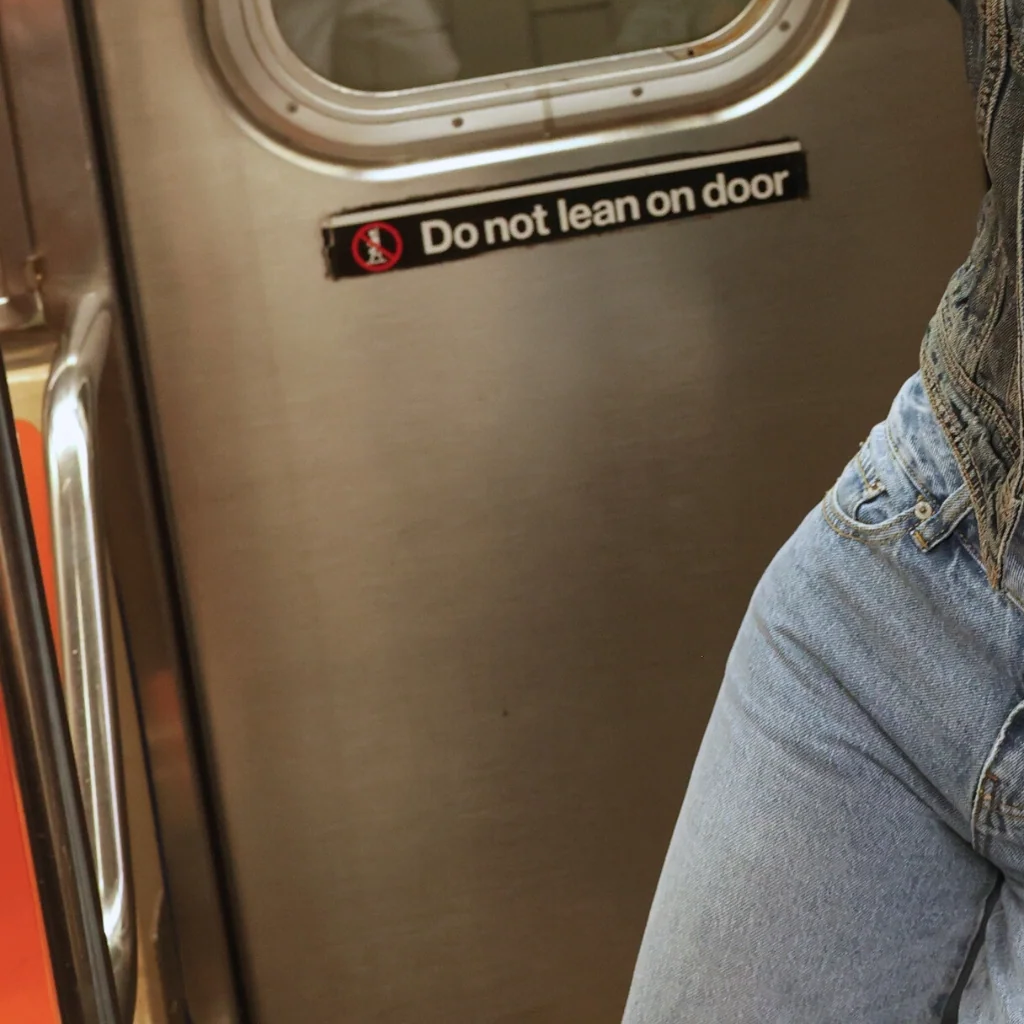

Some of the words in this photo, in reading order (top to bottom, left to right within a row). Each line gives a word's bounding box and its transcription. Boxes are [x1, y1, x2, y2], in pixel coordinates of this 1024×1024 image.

[421, 219, 479, 255] Do
[484, 204, 550, 245] not
[557, 195, 640, 232] lean
[647, 187, 695, 216] on
[702, 170, 789, 208] door
